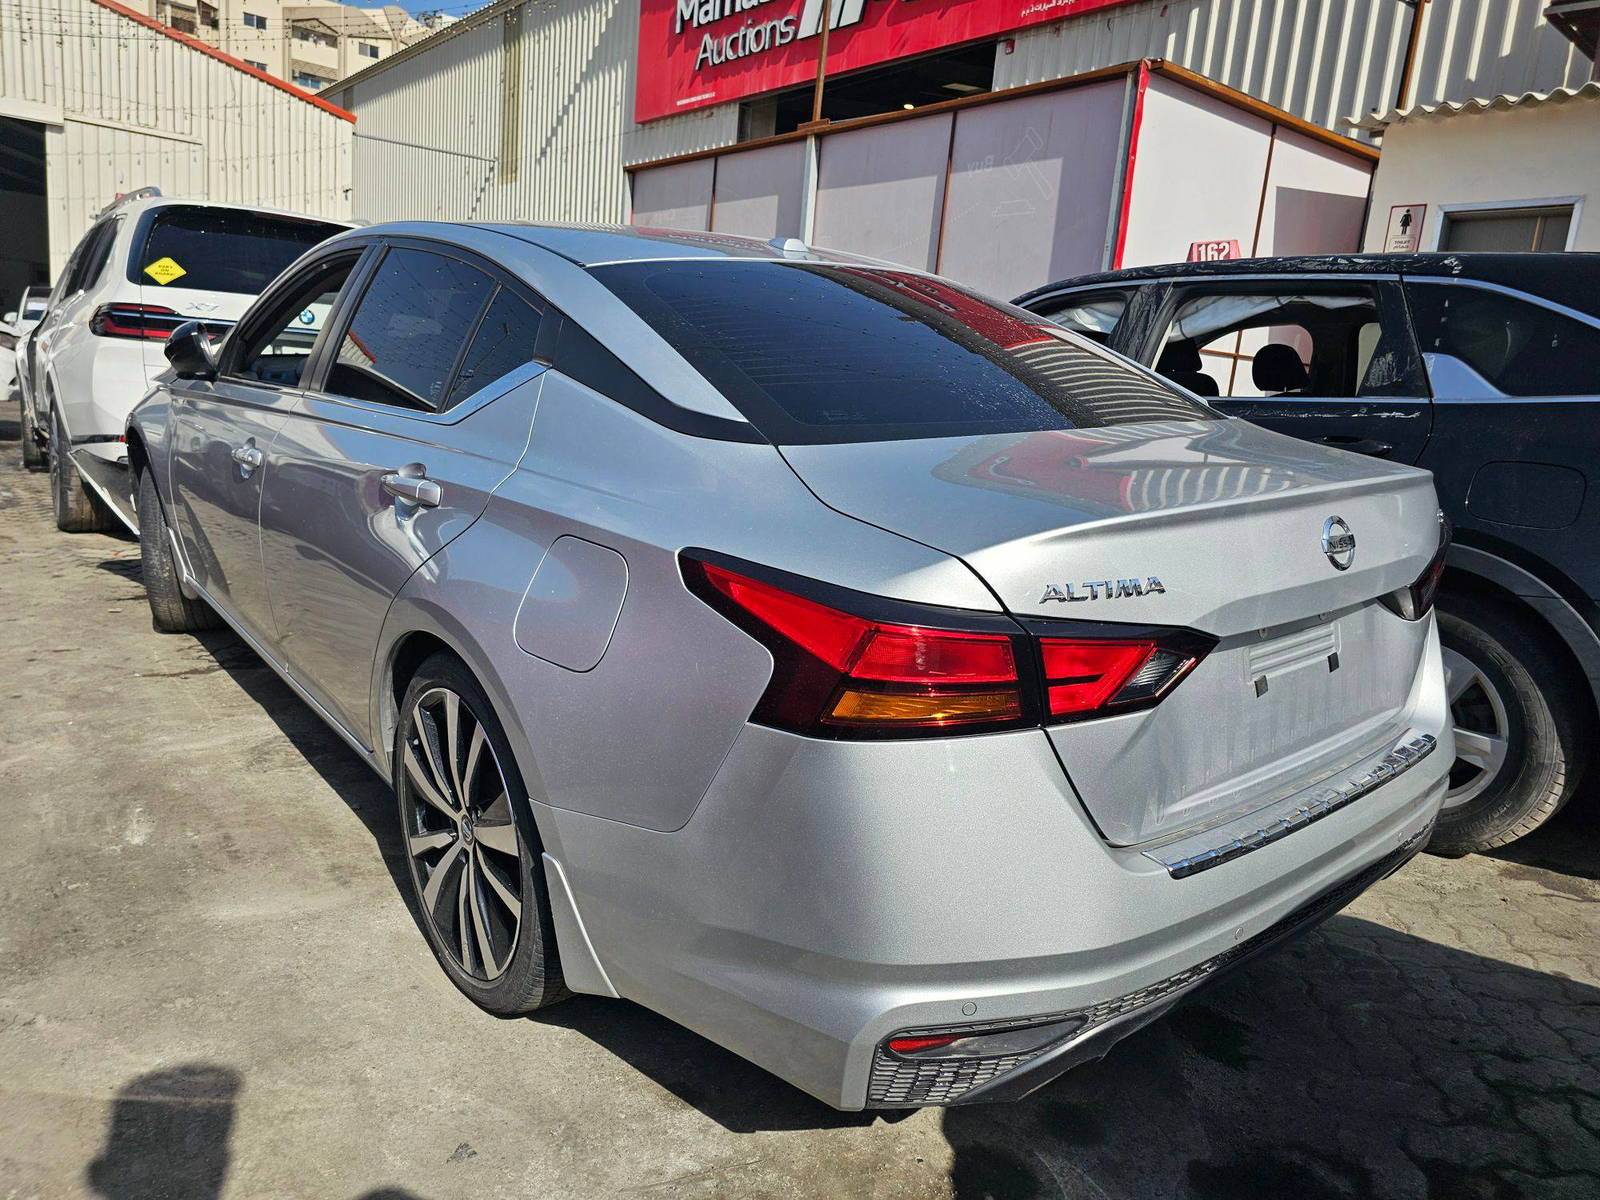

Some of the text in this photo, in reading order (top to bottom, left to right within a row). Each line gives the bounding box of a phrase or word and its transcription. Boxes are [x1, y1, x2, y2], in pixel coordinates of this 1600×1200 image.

[695, 15, 797, 71] Auctions
[1198, 242, 1230, 262] 162
[1038, 576, 1166, 604] ALTIMA
